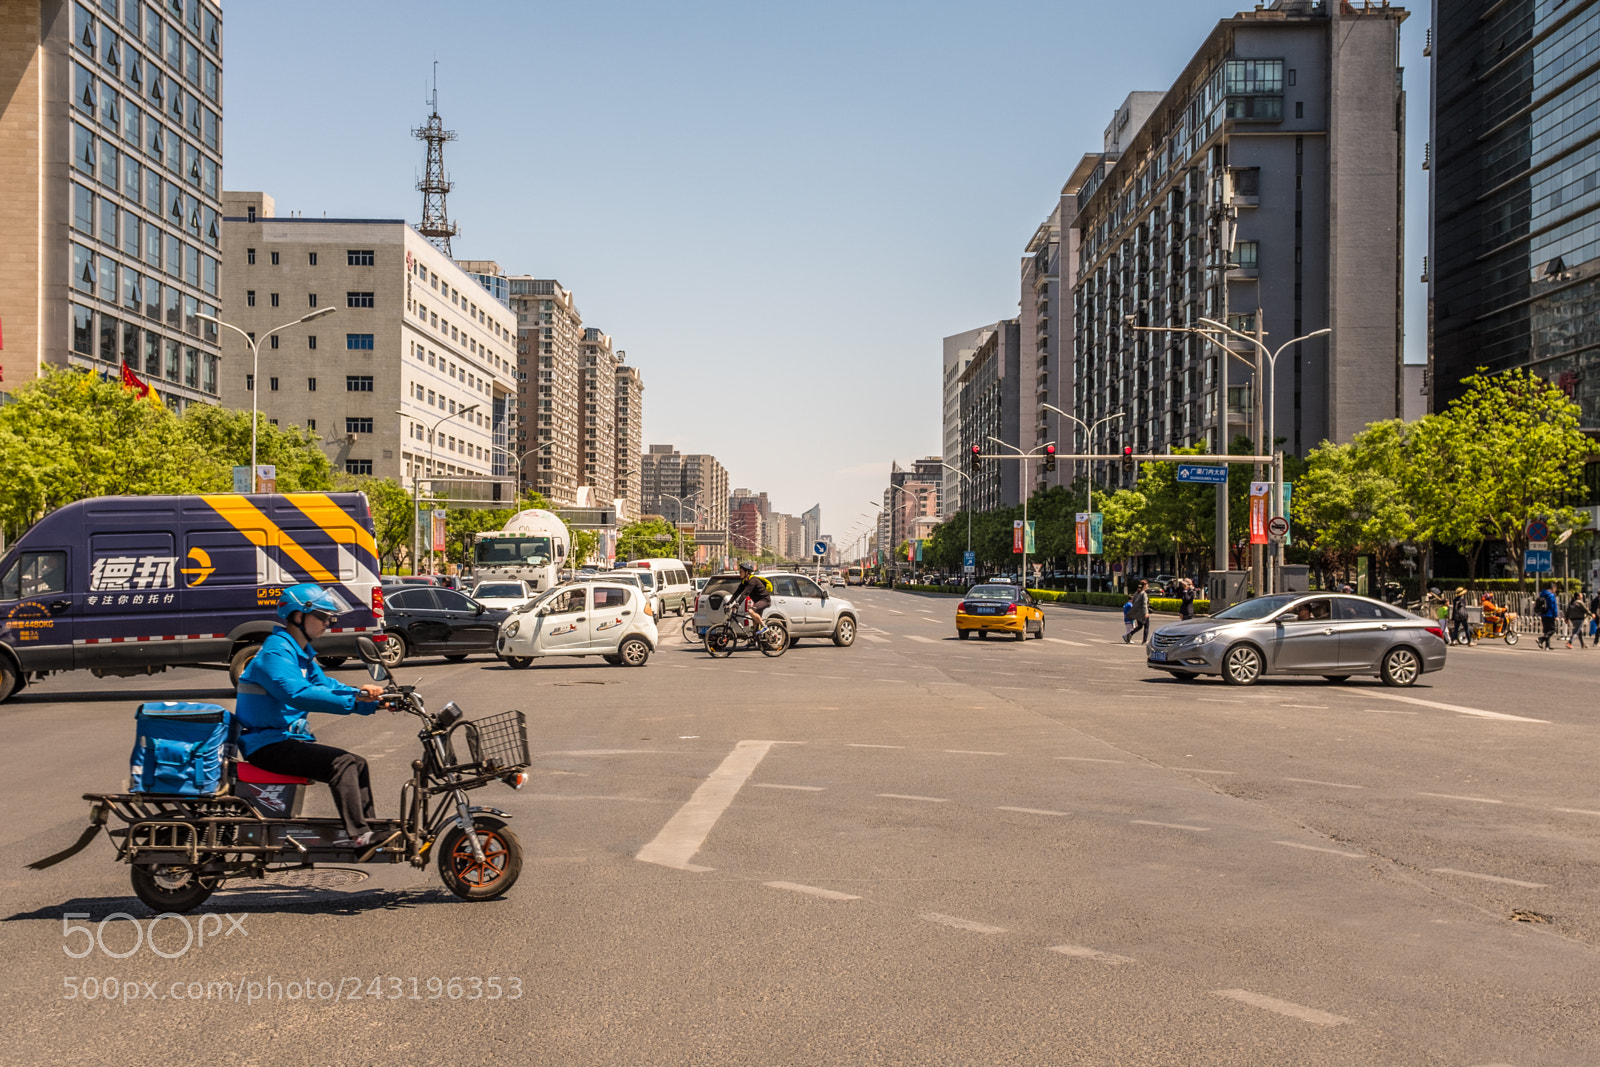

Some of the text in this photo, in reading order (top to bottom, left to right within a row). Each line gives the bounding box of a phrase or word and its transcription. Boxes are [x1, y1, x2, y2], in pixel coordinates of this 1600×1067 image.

[89, 556, 180, 591] 德邦
[87, 593, 175, 606] 专注你的托付
